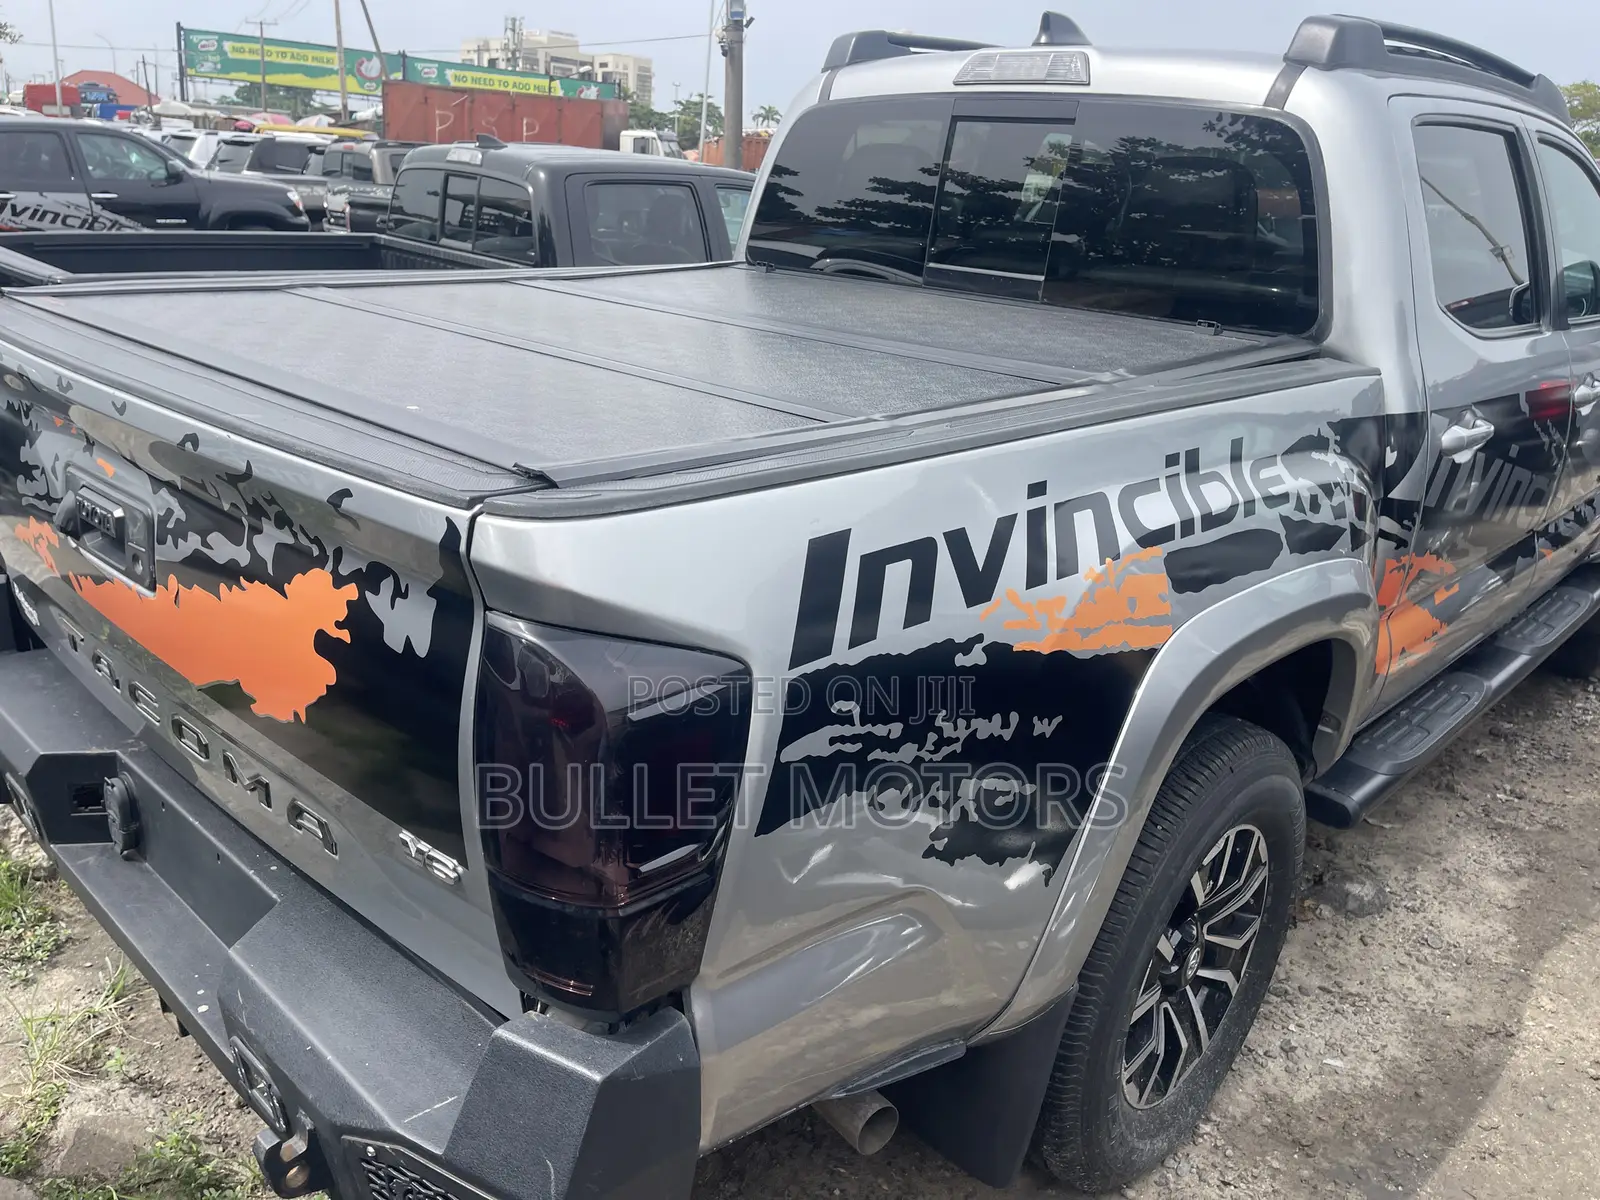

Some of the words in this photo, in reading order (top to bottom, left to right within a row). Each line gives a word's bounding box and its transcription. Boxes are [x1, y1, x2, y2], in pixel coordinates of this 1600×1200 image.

[231, 45, 246, 54] NO
[248, 48, 273, 57] NED
[274, 51, 288, 59] TO
[289, 53, 309, 62] ADD
[454, 74, 468, 84] NO
[471, 76, 495, 87] NEED
[498, 79, 510, 88] TO
[511, 81, 531, 91] ADD
[788, 437, 1289, 671] Invincible
[58, 616, 338, 859] TACOMA
